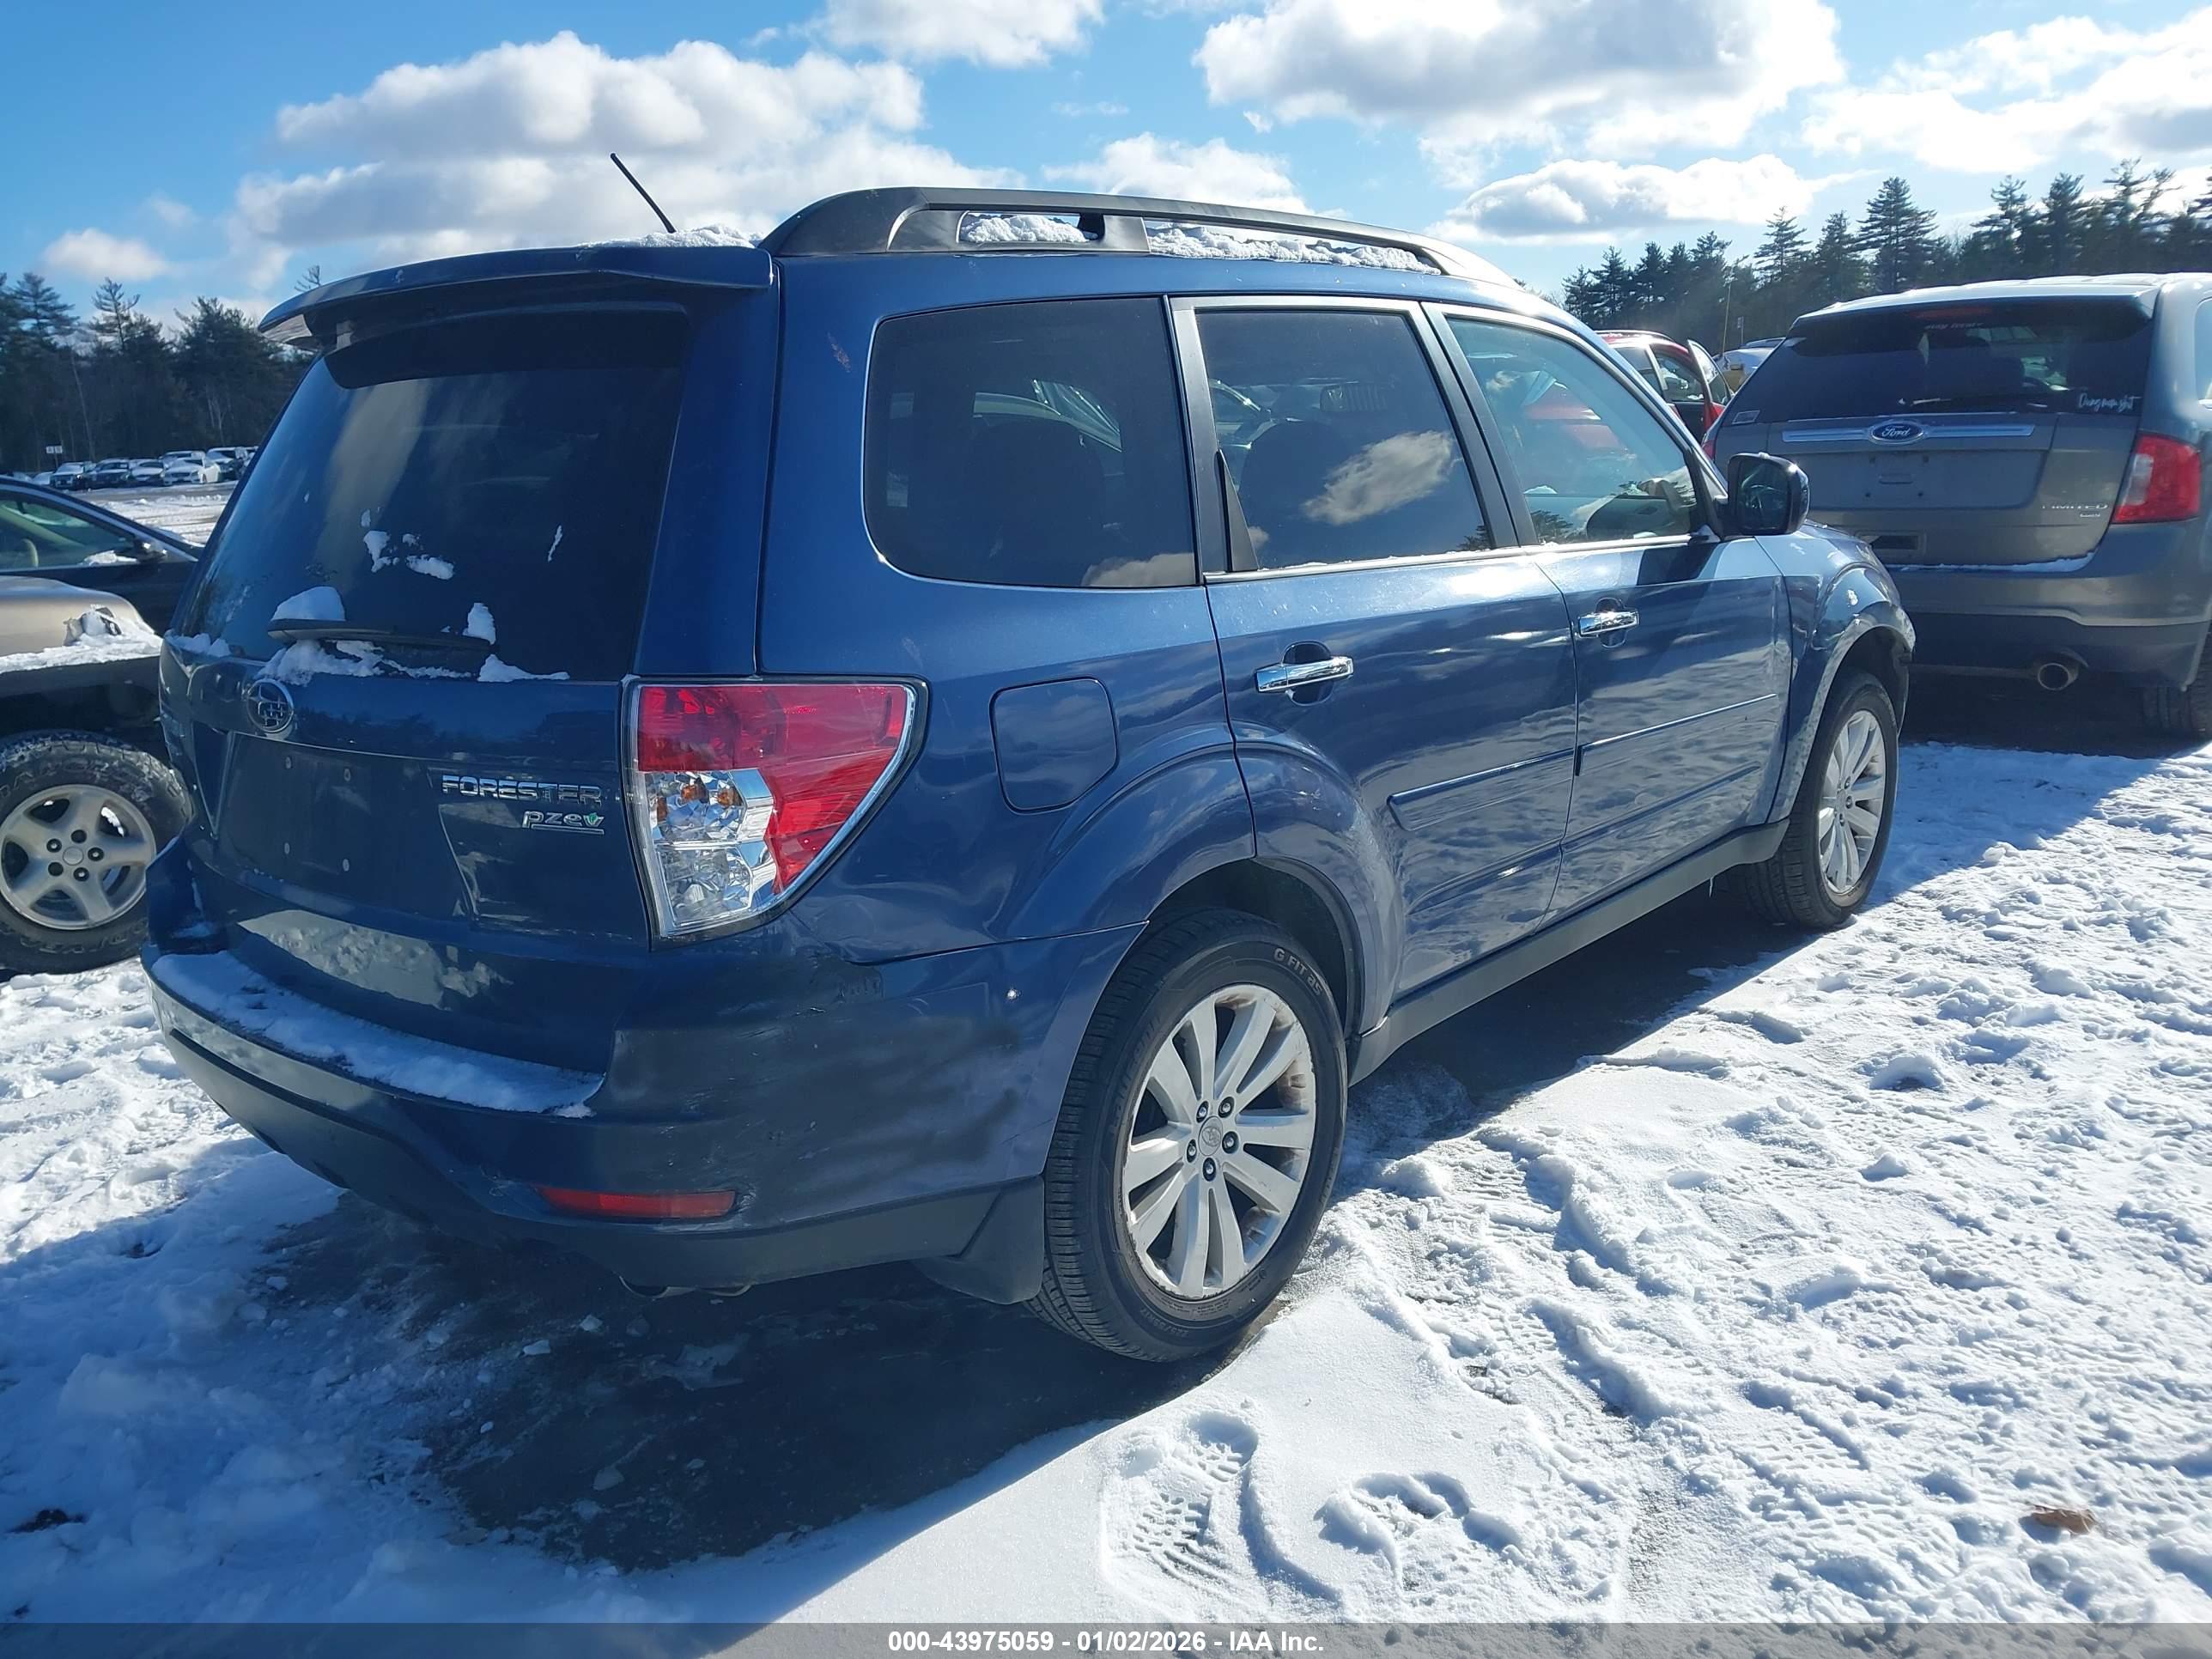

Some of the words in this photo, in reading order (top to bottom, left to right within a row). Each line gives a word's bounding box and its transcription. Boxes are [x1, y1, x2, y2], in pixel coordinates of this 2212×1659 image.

[1881, 426, 1911, 438] Ford
[441, 775, 603, 805] FORESTER
[1273, 947, 1285, 962] G
[1287, 954, 1308, 975] FIT
